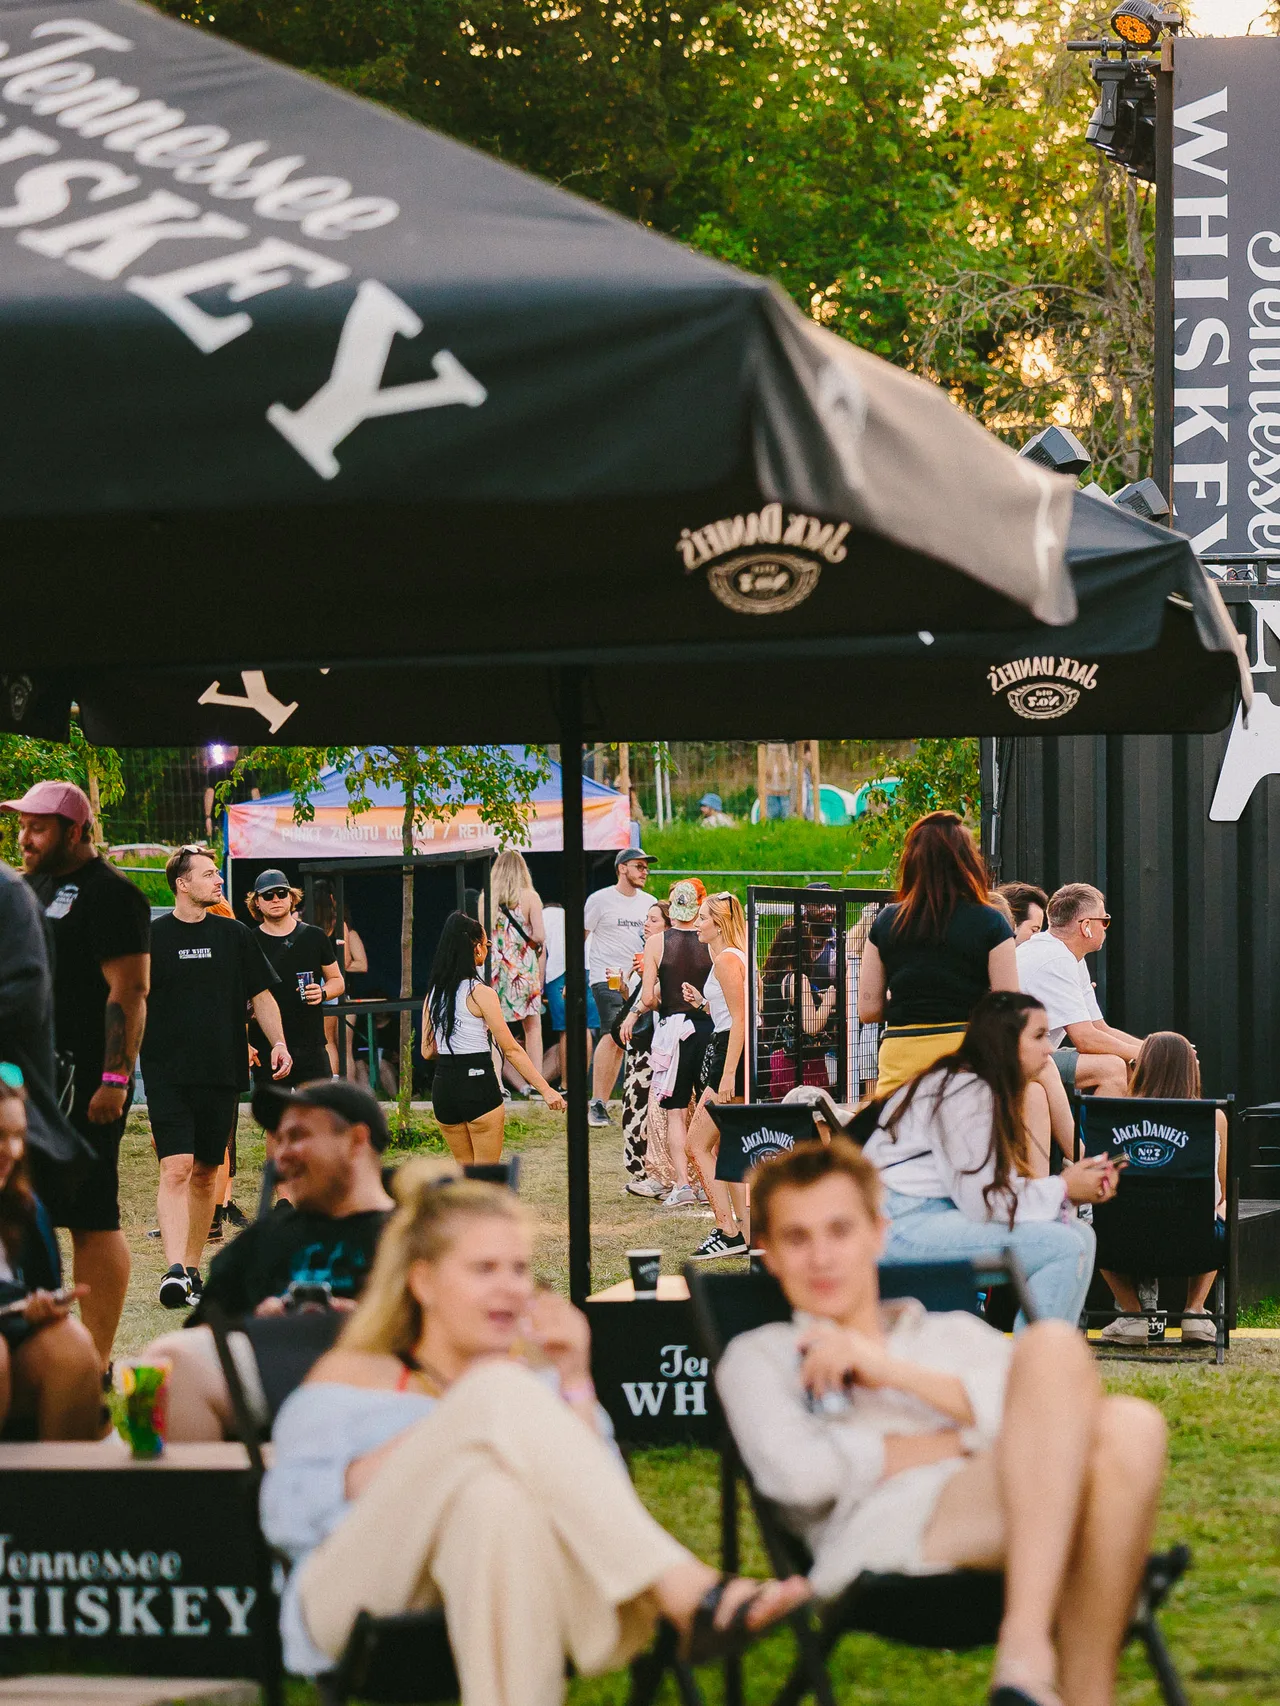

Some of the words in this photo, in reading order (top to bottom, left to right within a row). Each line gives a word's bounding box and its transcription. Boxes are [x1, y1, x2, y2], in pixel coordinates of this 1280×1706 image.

[0, 18, 400, 240] Tennessee
[741, 1130, 763, 1154] JACK
[1111, 1123, 1142, 1145] JACK
[1142, 1119, 1190, 1149] DANIEL'S
[621, 1381, 709, 1417] WH
